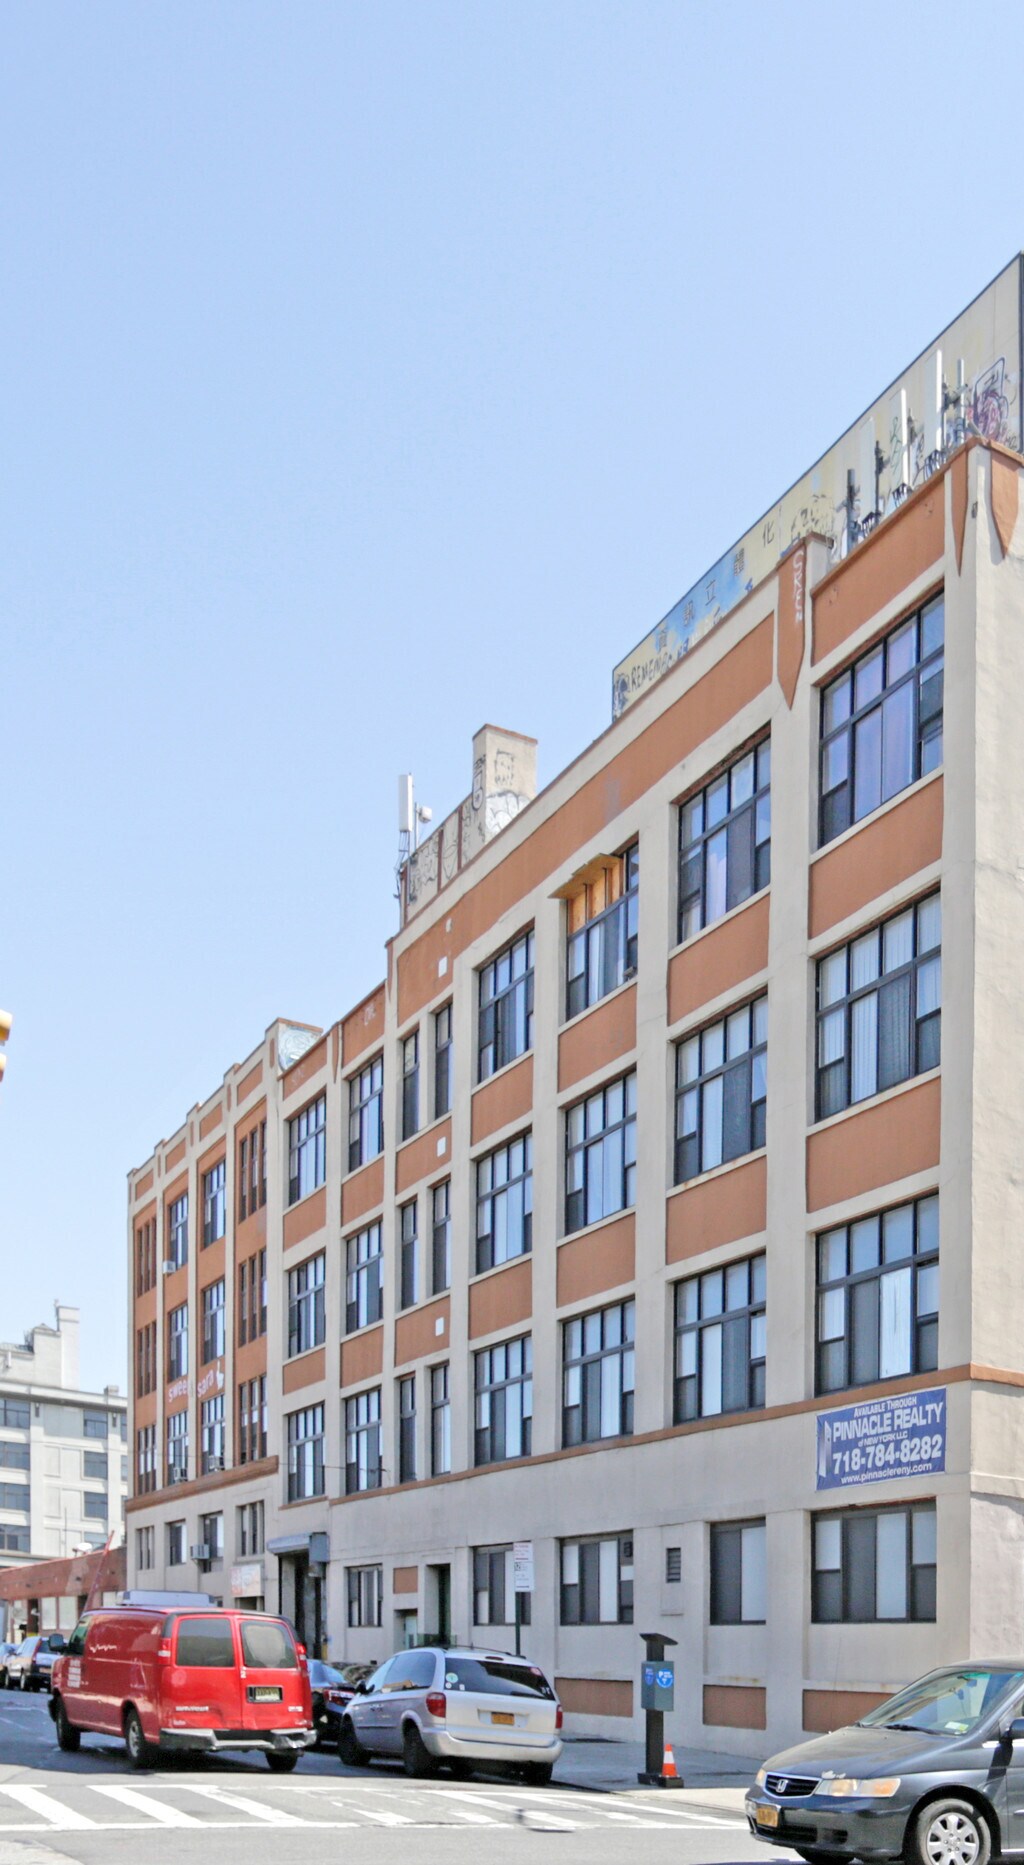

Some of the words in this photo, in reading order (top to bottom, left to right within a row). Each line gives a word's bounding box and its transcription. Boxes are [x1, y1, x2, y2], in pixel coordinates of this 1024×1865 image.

[833, 1412, 891, 1442] PINNACLE
[894, 1402, 943, 1431] REALTY
[854, 1402, 886, 1418] AVAILABLE
[887, 1396, 917, 1411] THROUGH
[864, 1437, 878, 1446] NEW
[878, 1433, 896, 1443] YORK
[896, 1430, 908, 1440] LLC
[833, 1434, 942, 1475] 718-784-8282
